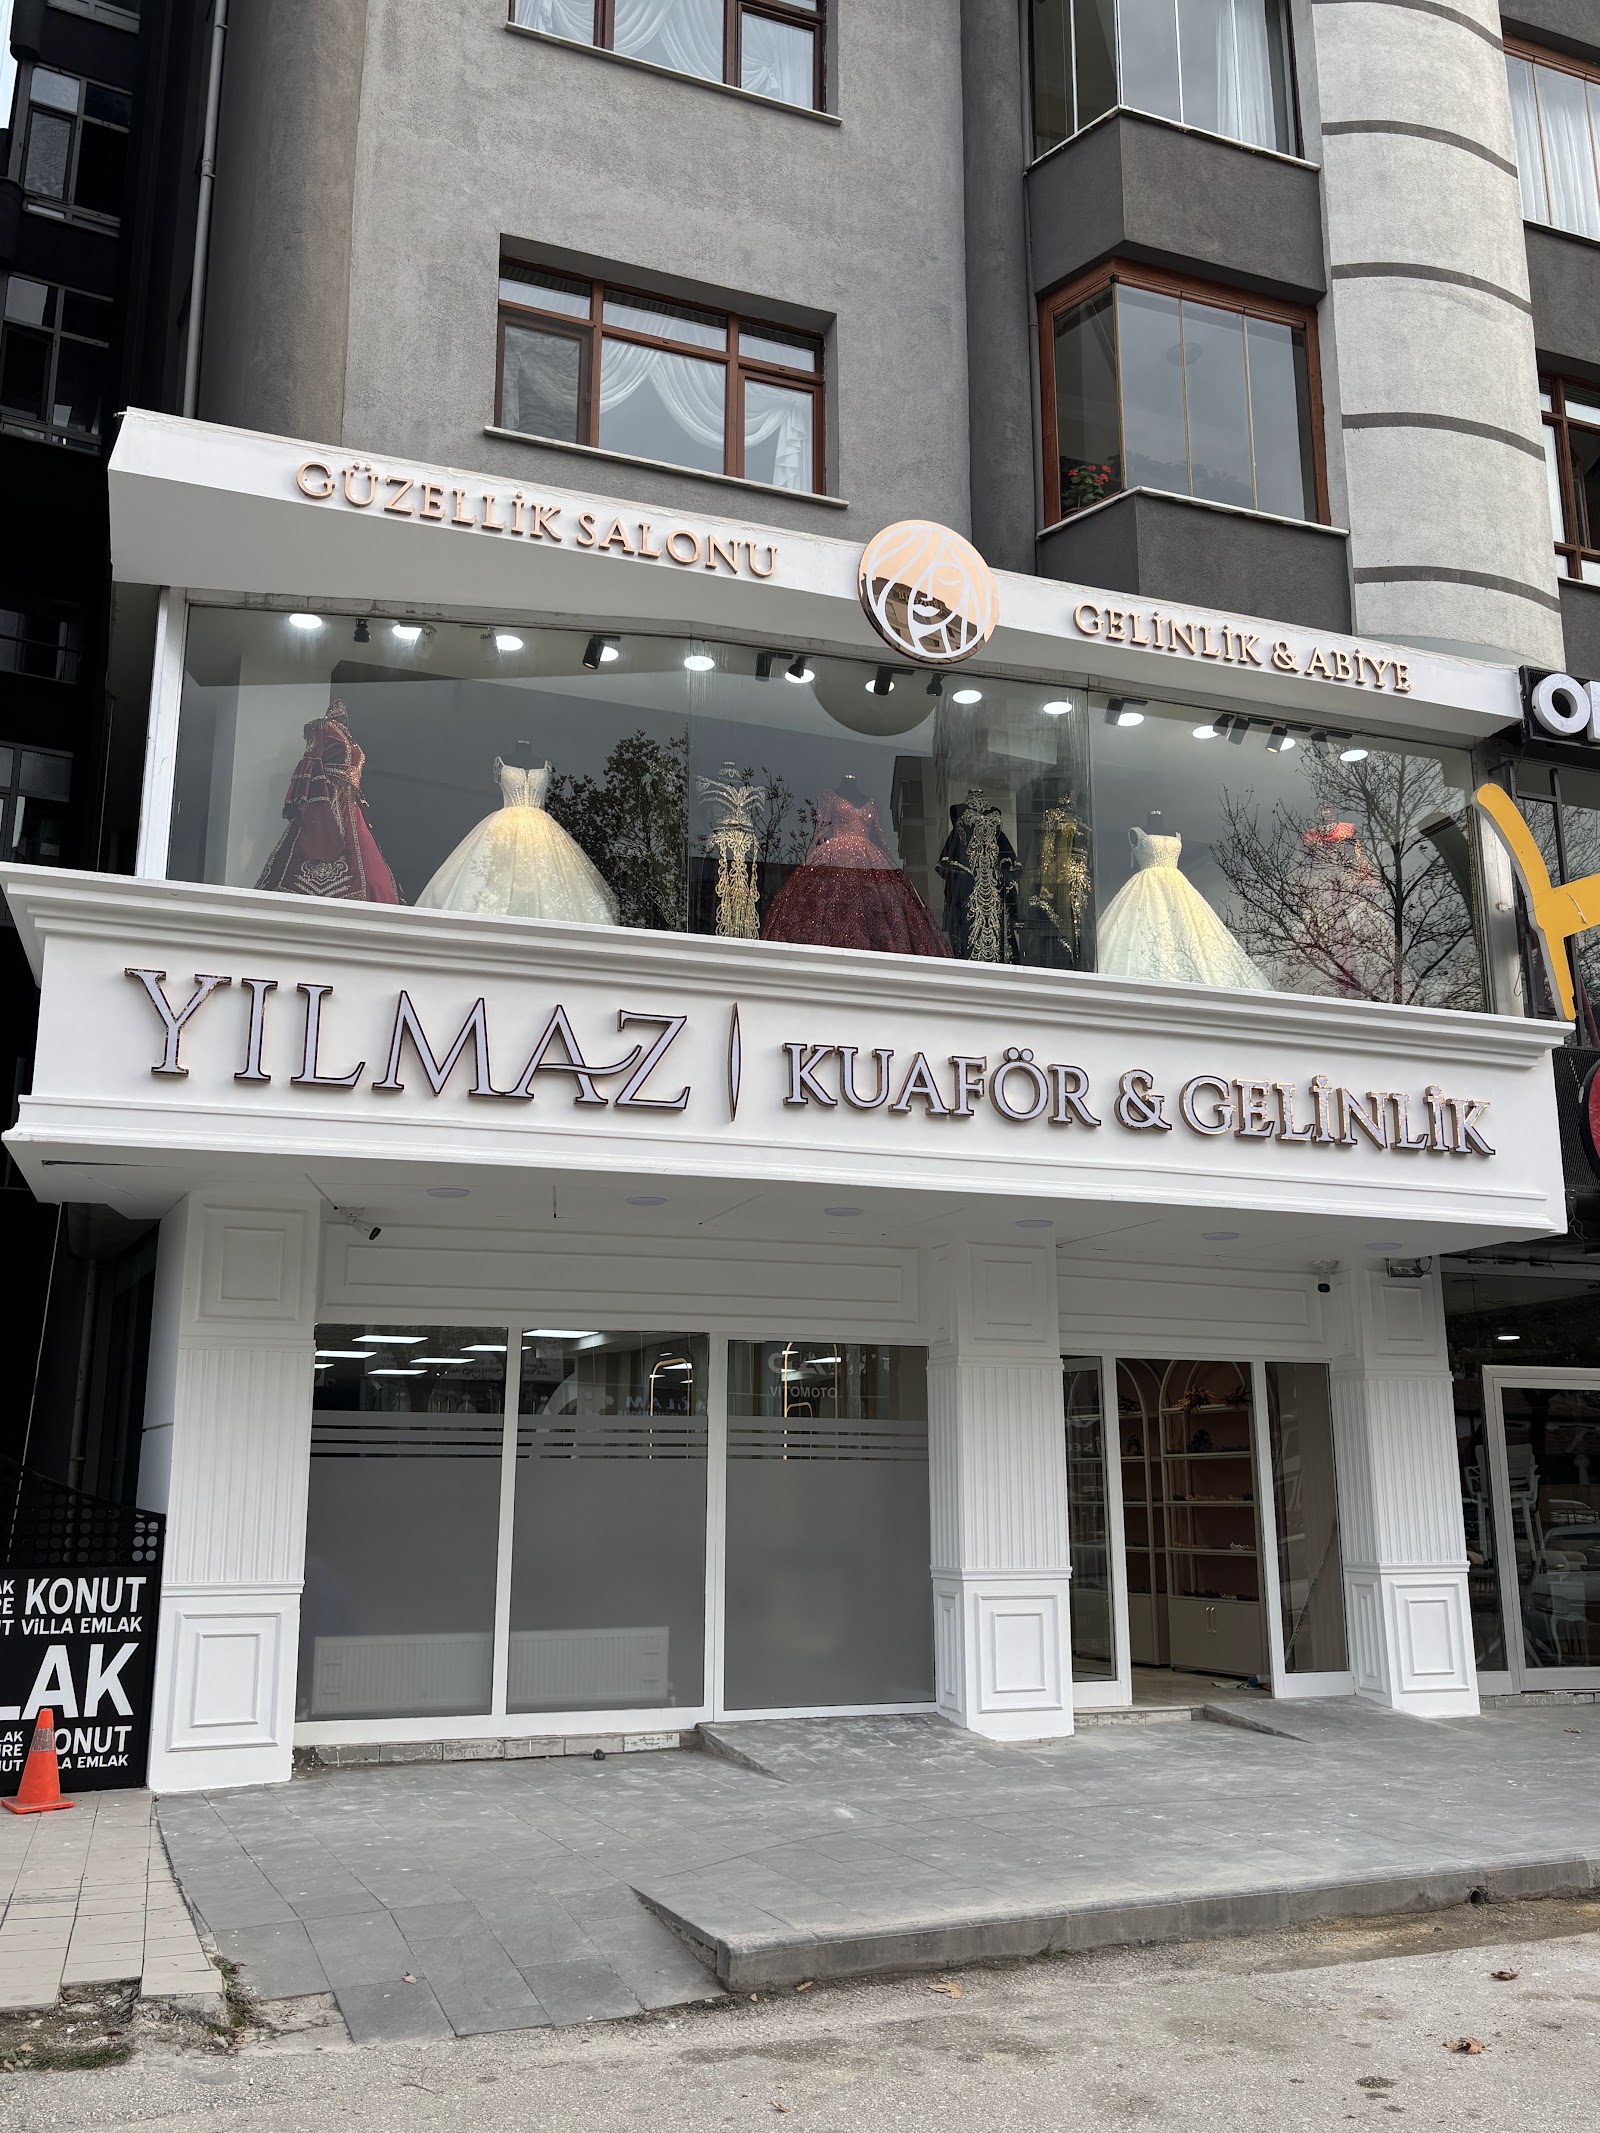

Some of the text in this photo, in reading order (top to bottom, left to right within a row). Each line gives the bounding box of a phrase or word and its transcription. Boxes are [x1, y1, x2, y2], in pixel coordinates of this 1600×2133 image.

[296, 461, 778, 578] GÜZELLİK SALONU
[1073, 603, 1412, 694] GELİNLİK & ABİYE
[125, 967, 691, 1111] YILMAZ
[782, 1043, 1497, 1156] KUAFÖR & GELİNLİK
[25, 1577, 147, 1615] KONUT
[80, 1616, 143, 1634] EMLAK
[77, 1754, 129, 1769] EMLAK
